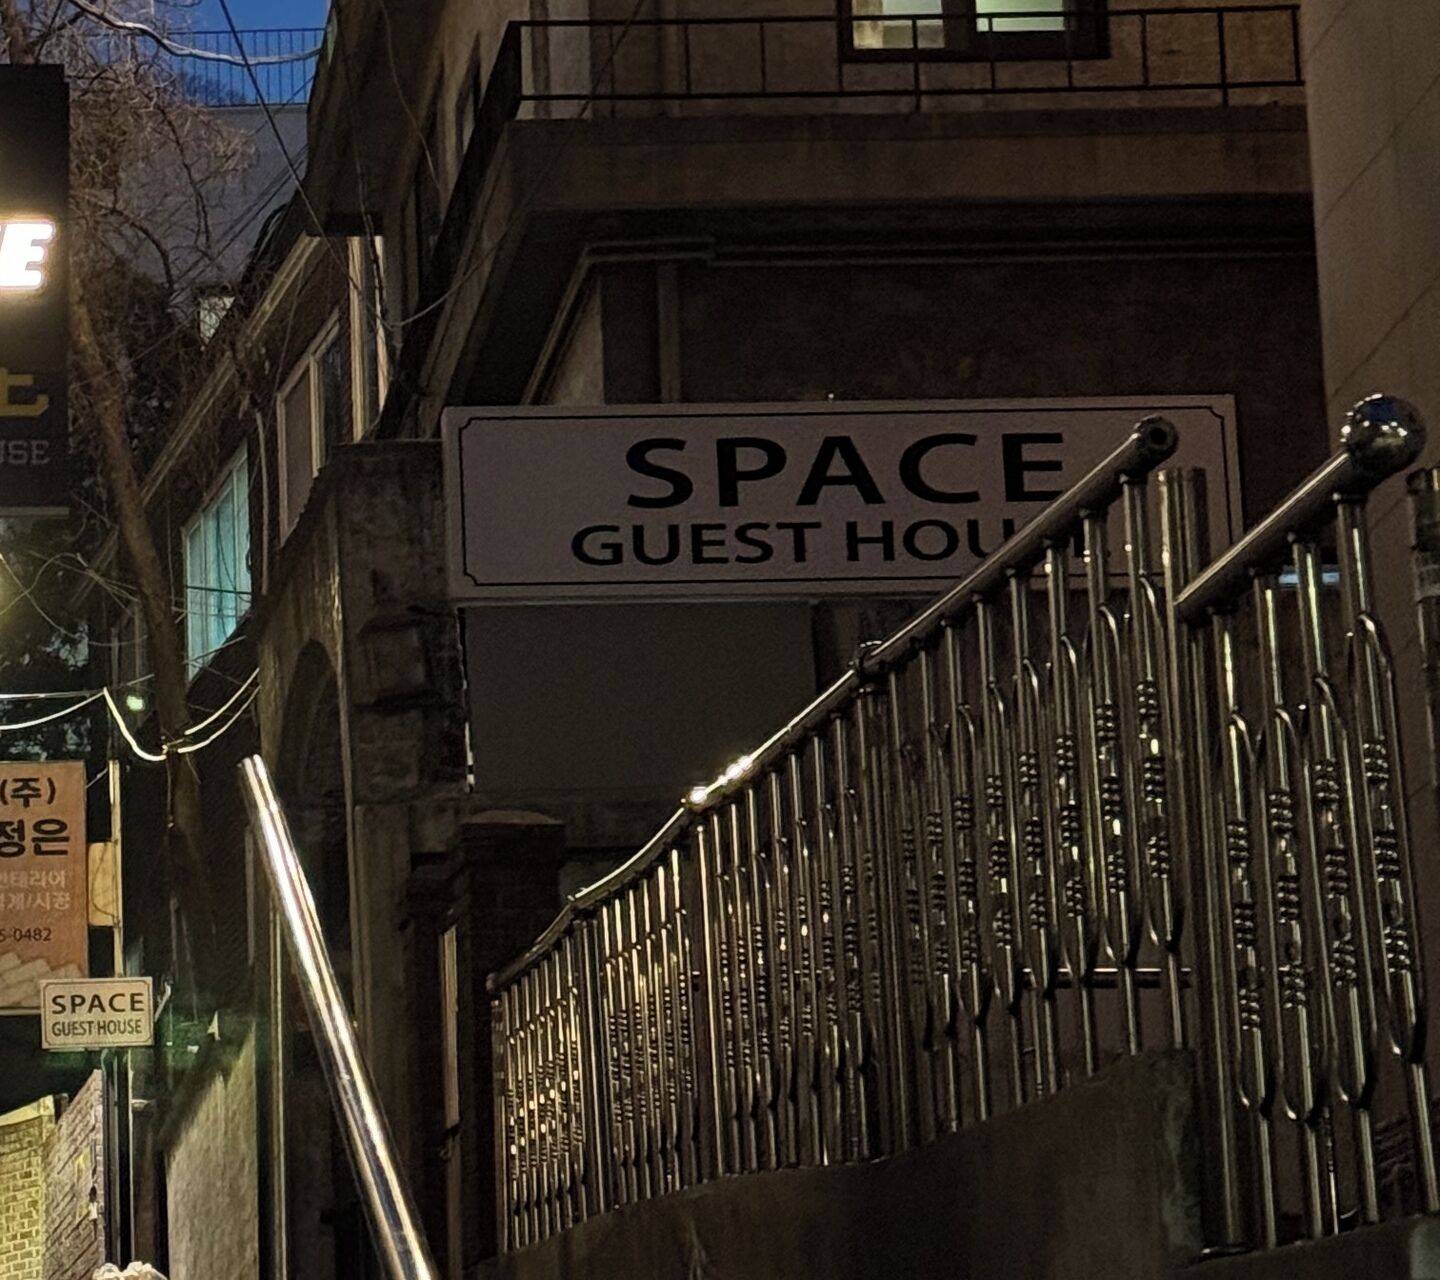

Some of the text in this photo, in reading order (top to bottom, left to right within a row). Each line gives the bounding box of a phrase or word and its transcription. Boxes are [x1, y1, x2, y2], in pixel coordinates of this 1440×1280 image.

[626, 432, 1065, 508] SPACE
[572, 518, 1084, 565] GUEST HOU
[0, 777, 56, 808] (주)
[51, 992, 145, 1015] SPACE
[51, 1019, 143, 1037] GUEST HOUSE
